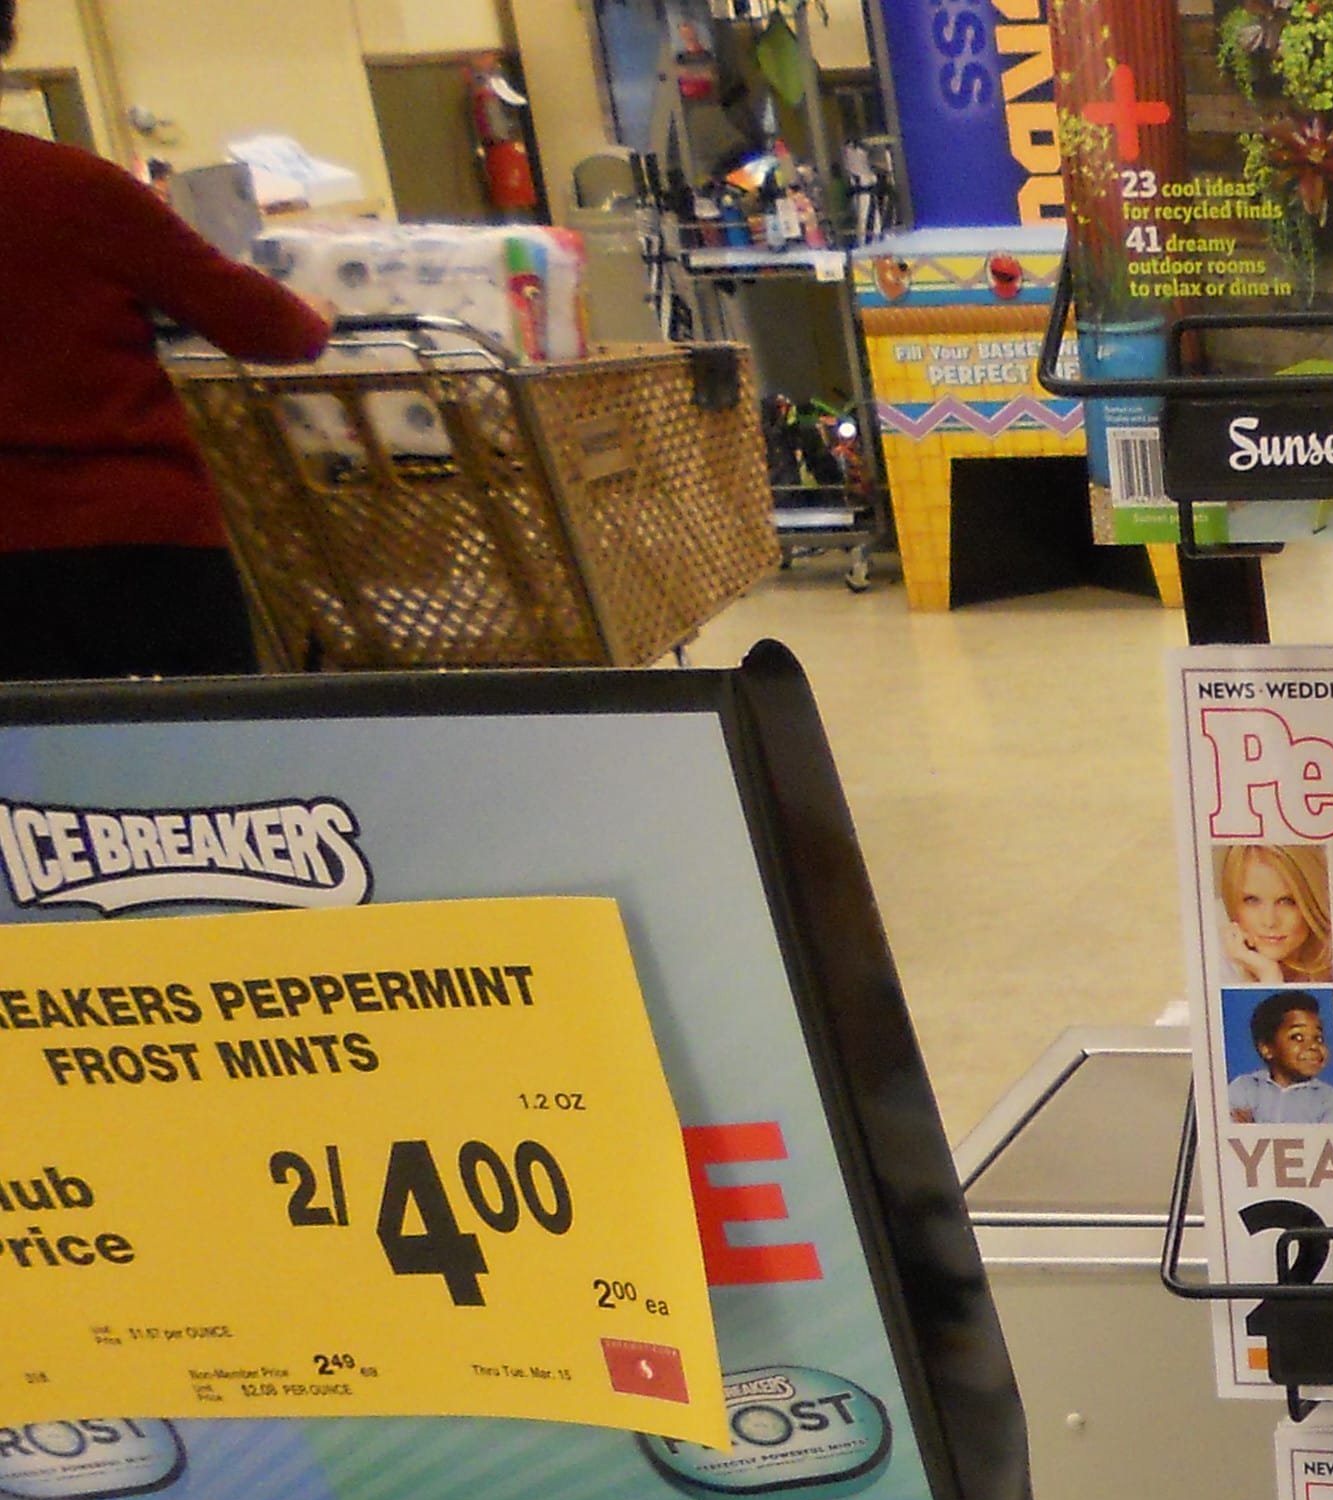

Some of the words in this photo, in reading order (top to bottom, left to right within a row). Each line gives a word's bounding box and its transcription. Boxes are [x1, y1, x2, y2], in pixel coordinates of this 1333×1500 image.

[1121, 171, 1157, 197] 23
[1162, 180, 1198, 197] cool
[1203, 177, 1255, 197] ideas
[1122, 202, 1150, 221] for
[1154, 200, 1228, 222] recycled
[1232, 200, 1282, 220] finds
[1126, 227, 1160, 253] 41
[1164, 235, 1235, 257] dreamy
[1128, 258, 1203, 276] outdoor
[1207, 260, 1265, 276] rooms
[1130, 280, 1150, 298] to
[1154, 278, 1203, 297] relax
[1205, 282, 1226, 297] or
[1229, 278, 1269, 296] dine
[1272, 278, 1291, 296] in
[1198, 681, 1256, 699] NEWS
[3, 806, 92, 901] ICE
[94, 800, 360, 890] BREAKERS
[210, 965, 535, 1021] PEPPERMINT
[44, 1044, 203, 1086] FROST
[217, 1033, 380, 1079] MINTS
[520, 1093, 550, 1110] 1.2
[555, 1093, 586, 1110] OZ
